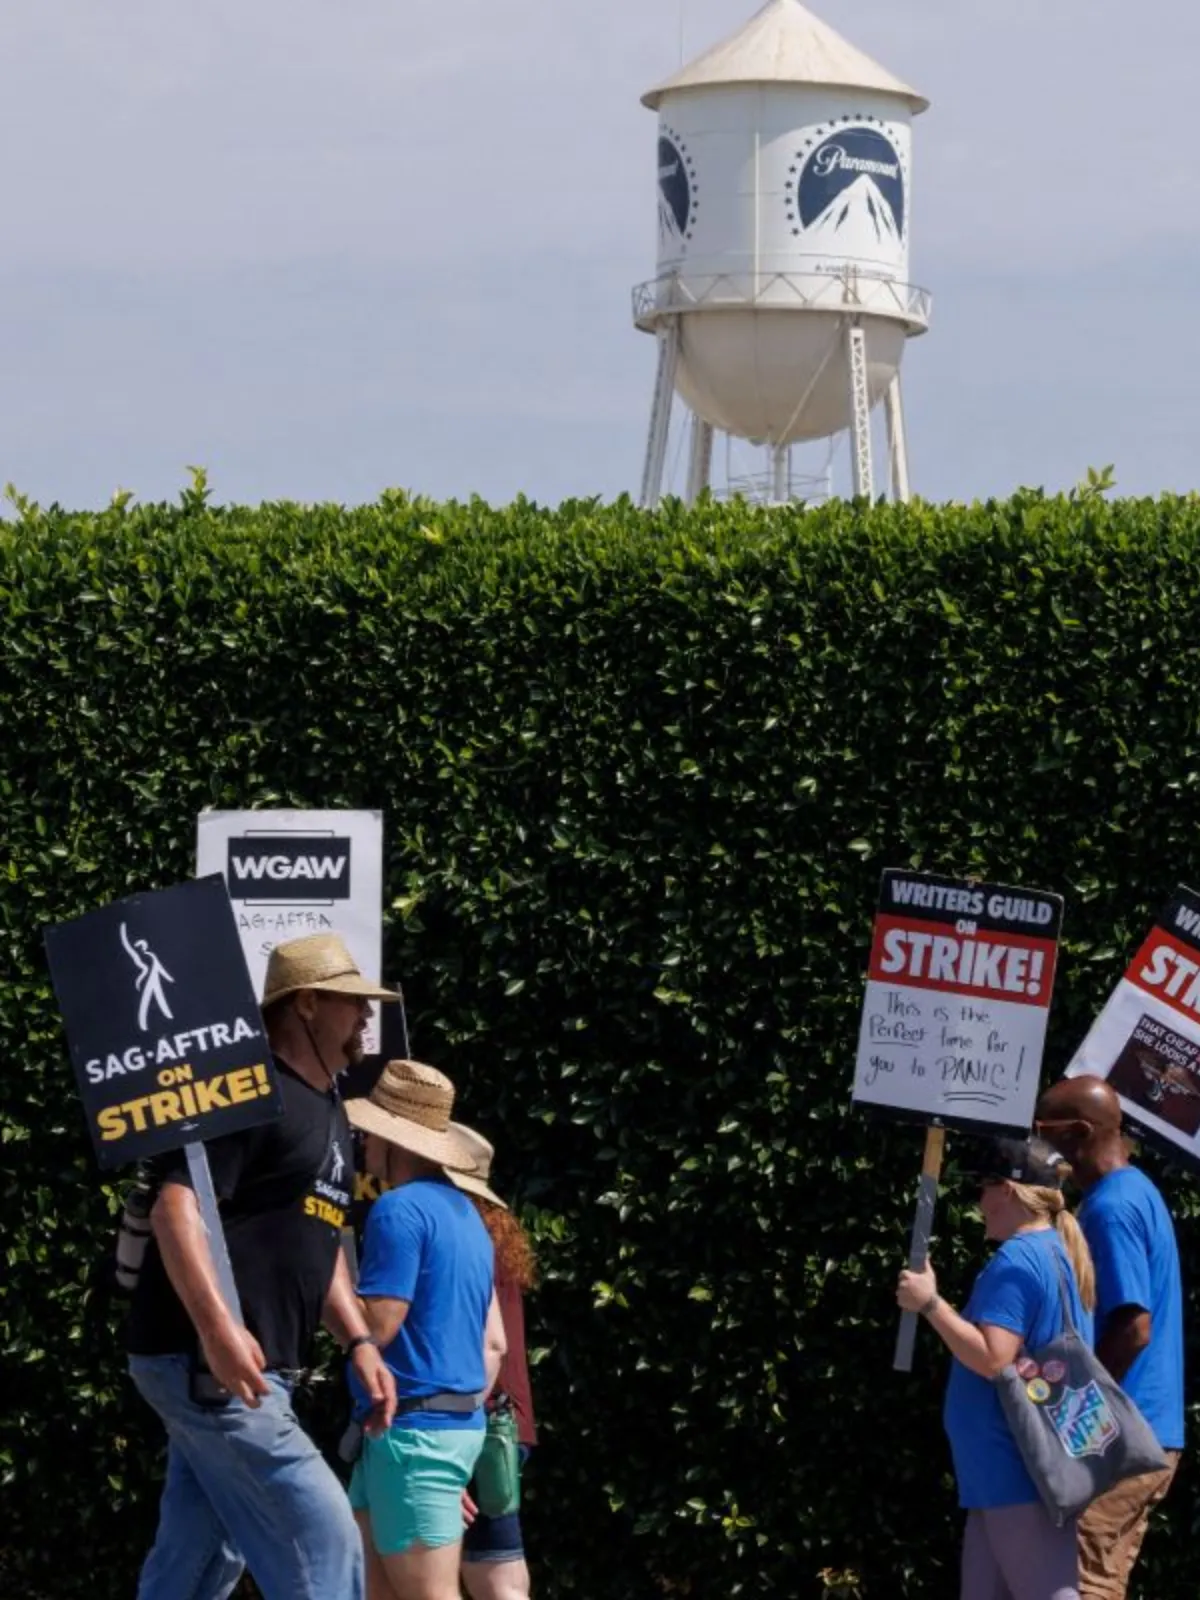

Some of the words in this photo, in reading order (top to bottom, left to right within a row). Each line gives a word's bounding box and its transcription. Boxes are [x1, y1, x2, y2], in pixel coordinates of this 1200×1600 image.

[231, 855, 346, 880] WGAW
[891, 879, 984, 915] WRITERS
[988, 895, 1052, 924] GUILD
[239, 911, 332, 931] AG-AFTRA
[956, 919, 977, 935] ON
[880, 928, 1045, 996] STRIKE!
[883, 991, 921, 1017] This
[933, 1006, 949, 1022] is
[961, 1006, 990, 1023] the
[987, 1030, 1009, 1053] for
[1140, 1017, 1166, 1038] THAT
[1133, 1029, 1154, 1046] SHE
[1187, 1060, 1199, 1072] A
[157, 1063, 193, 1086] ON
[864, 1055, 895, 1086] you
[97, 1063, 271, 1141] STRIKE!
